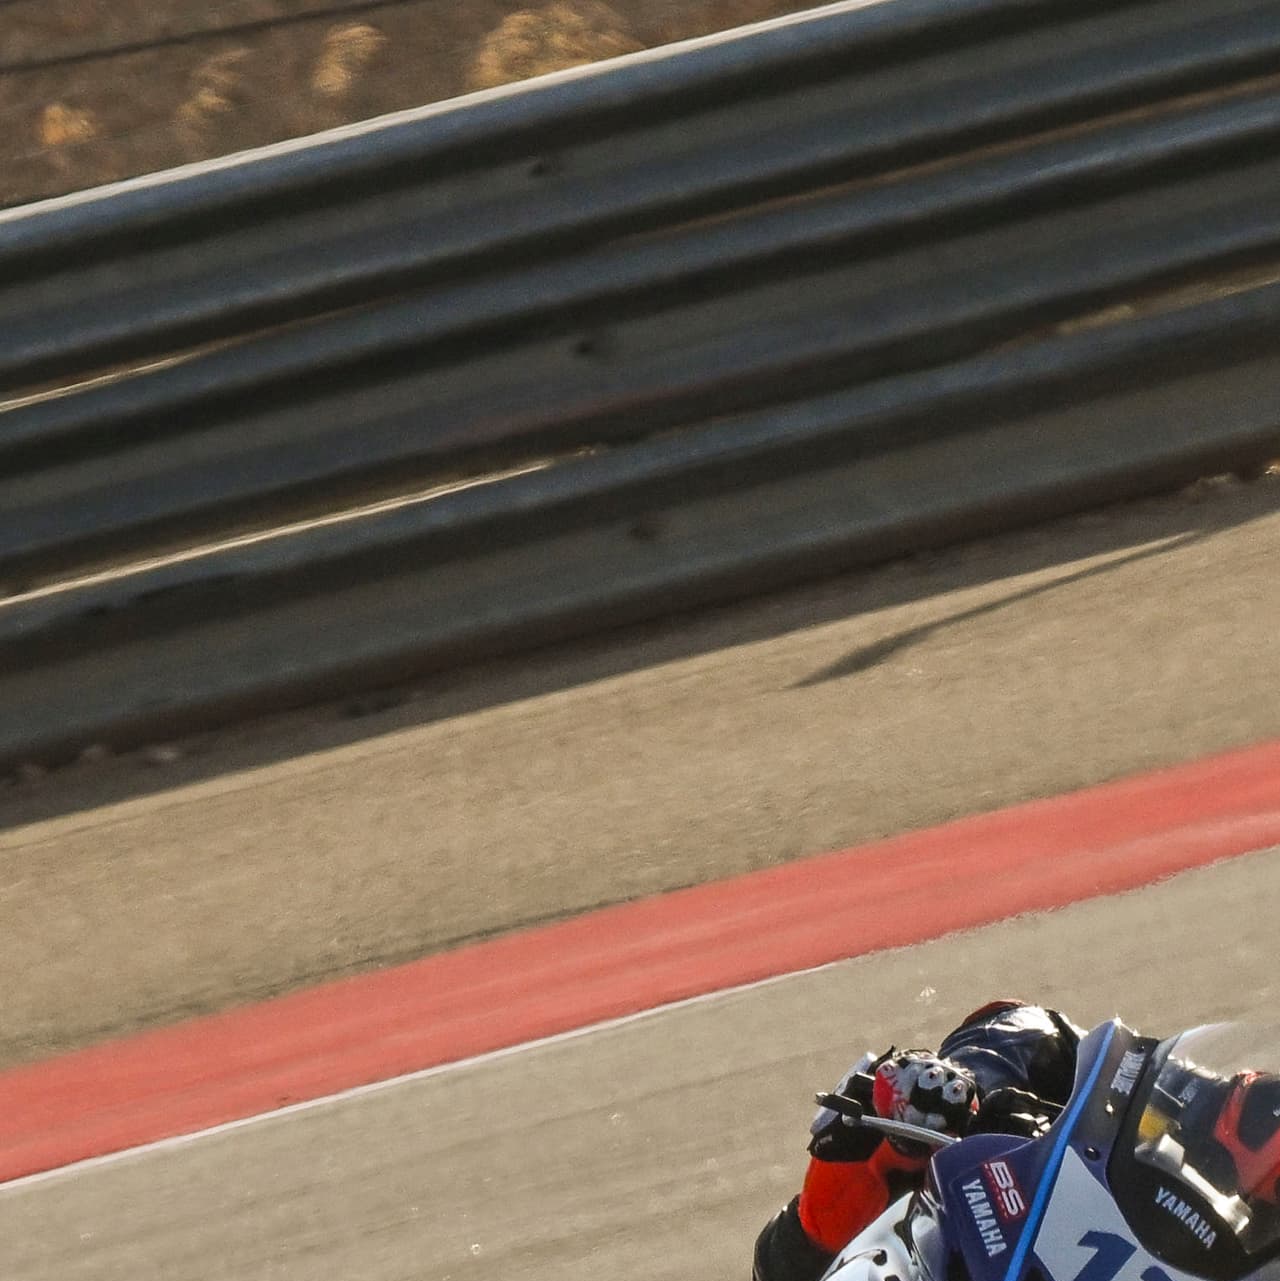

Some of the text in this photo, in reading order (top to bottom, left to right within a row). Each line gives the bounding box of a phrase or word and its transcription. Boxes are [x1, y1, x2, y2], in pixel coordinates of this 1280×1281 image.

[961, 1177, 1008, 1258] YAMAHA
[990, 1161, 1025, 1216] BS
[1154, 1186, 1218, 1250] YAMAHA
